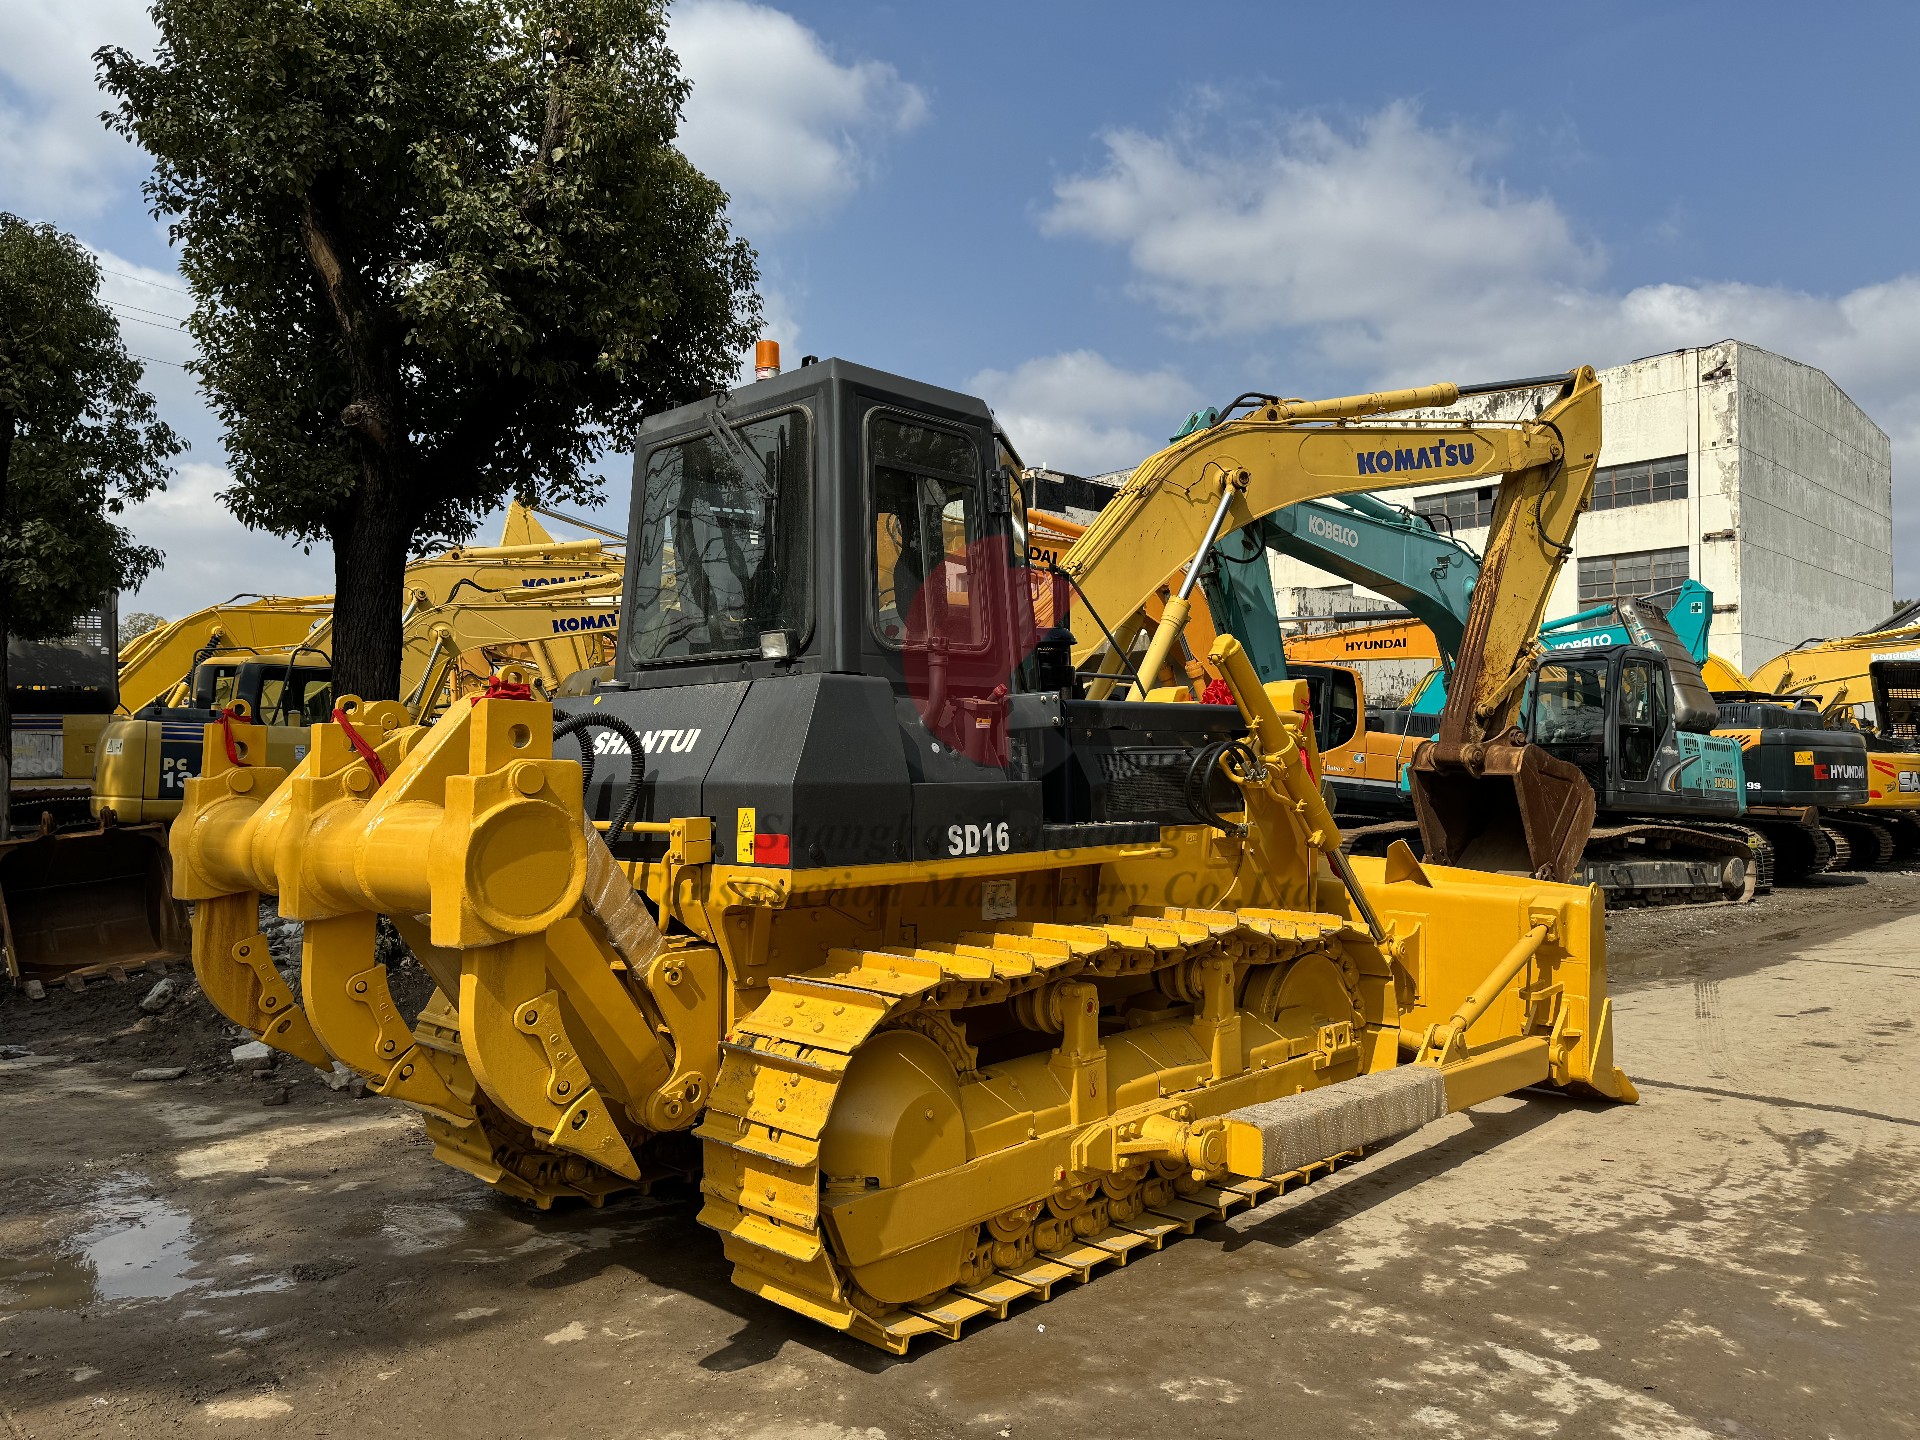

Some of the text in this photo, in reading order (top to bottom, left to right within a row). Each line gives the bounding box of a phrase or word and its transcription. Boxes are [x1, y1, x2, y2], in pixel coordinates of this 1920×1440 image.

[1357, 439, 1475, 475] KOMATSU
[1308, 515, 1359, 548] KOBELCO
[1345, 638, 1407, 652] HYUNDAI
[163, 757, 187, 771] PC
[1830, 764, 1865, 779] HYUNDAI
[947, 821, 1010, 856] SD16
